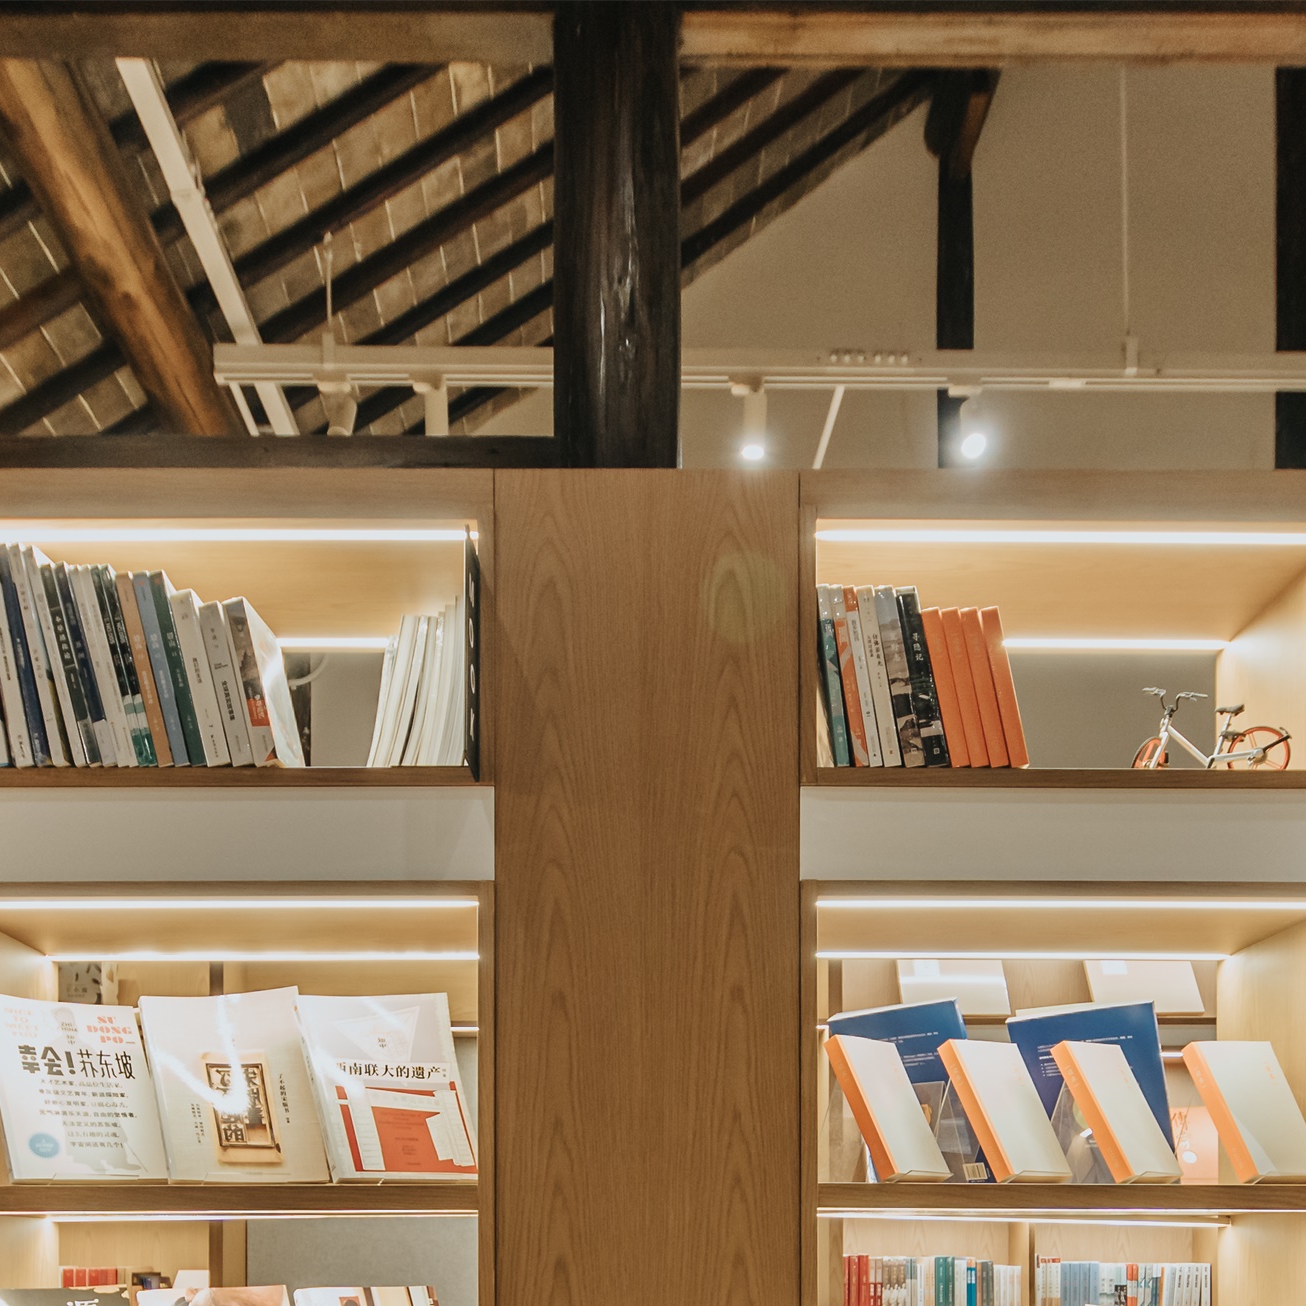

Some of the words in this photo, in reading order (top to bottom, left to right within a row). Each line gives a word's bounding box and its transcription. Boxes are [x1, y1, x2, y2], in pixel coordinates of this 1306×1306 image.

[912, 632, 924, 661] 寻隐记
[87, 1025, 133, 1035] DONG
